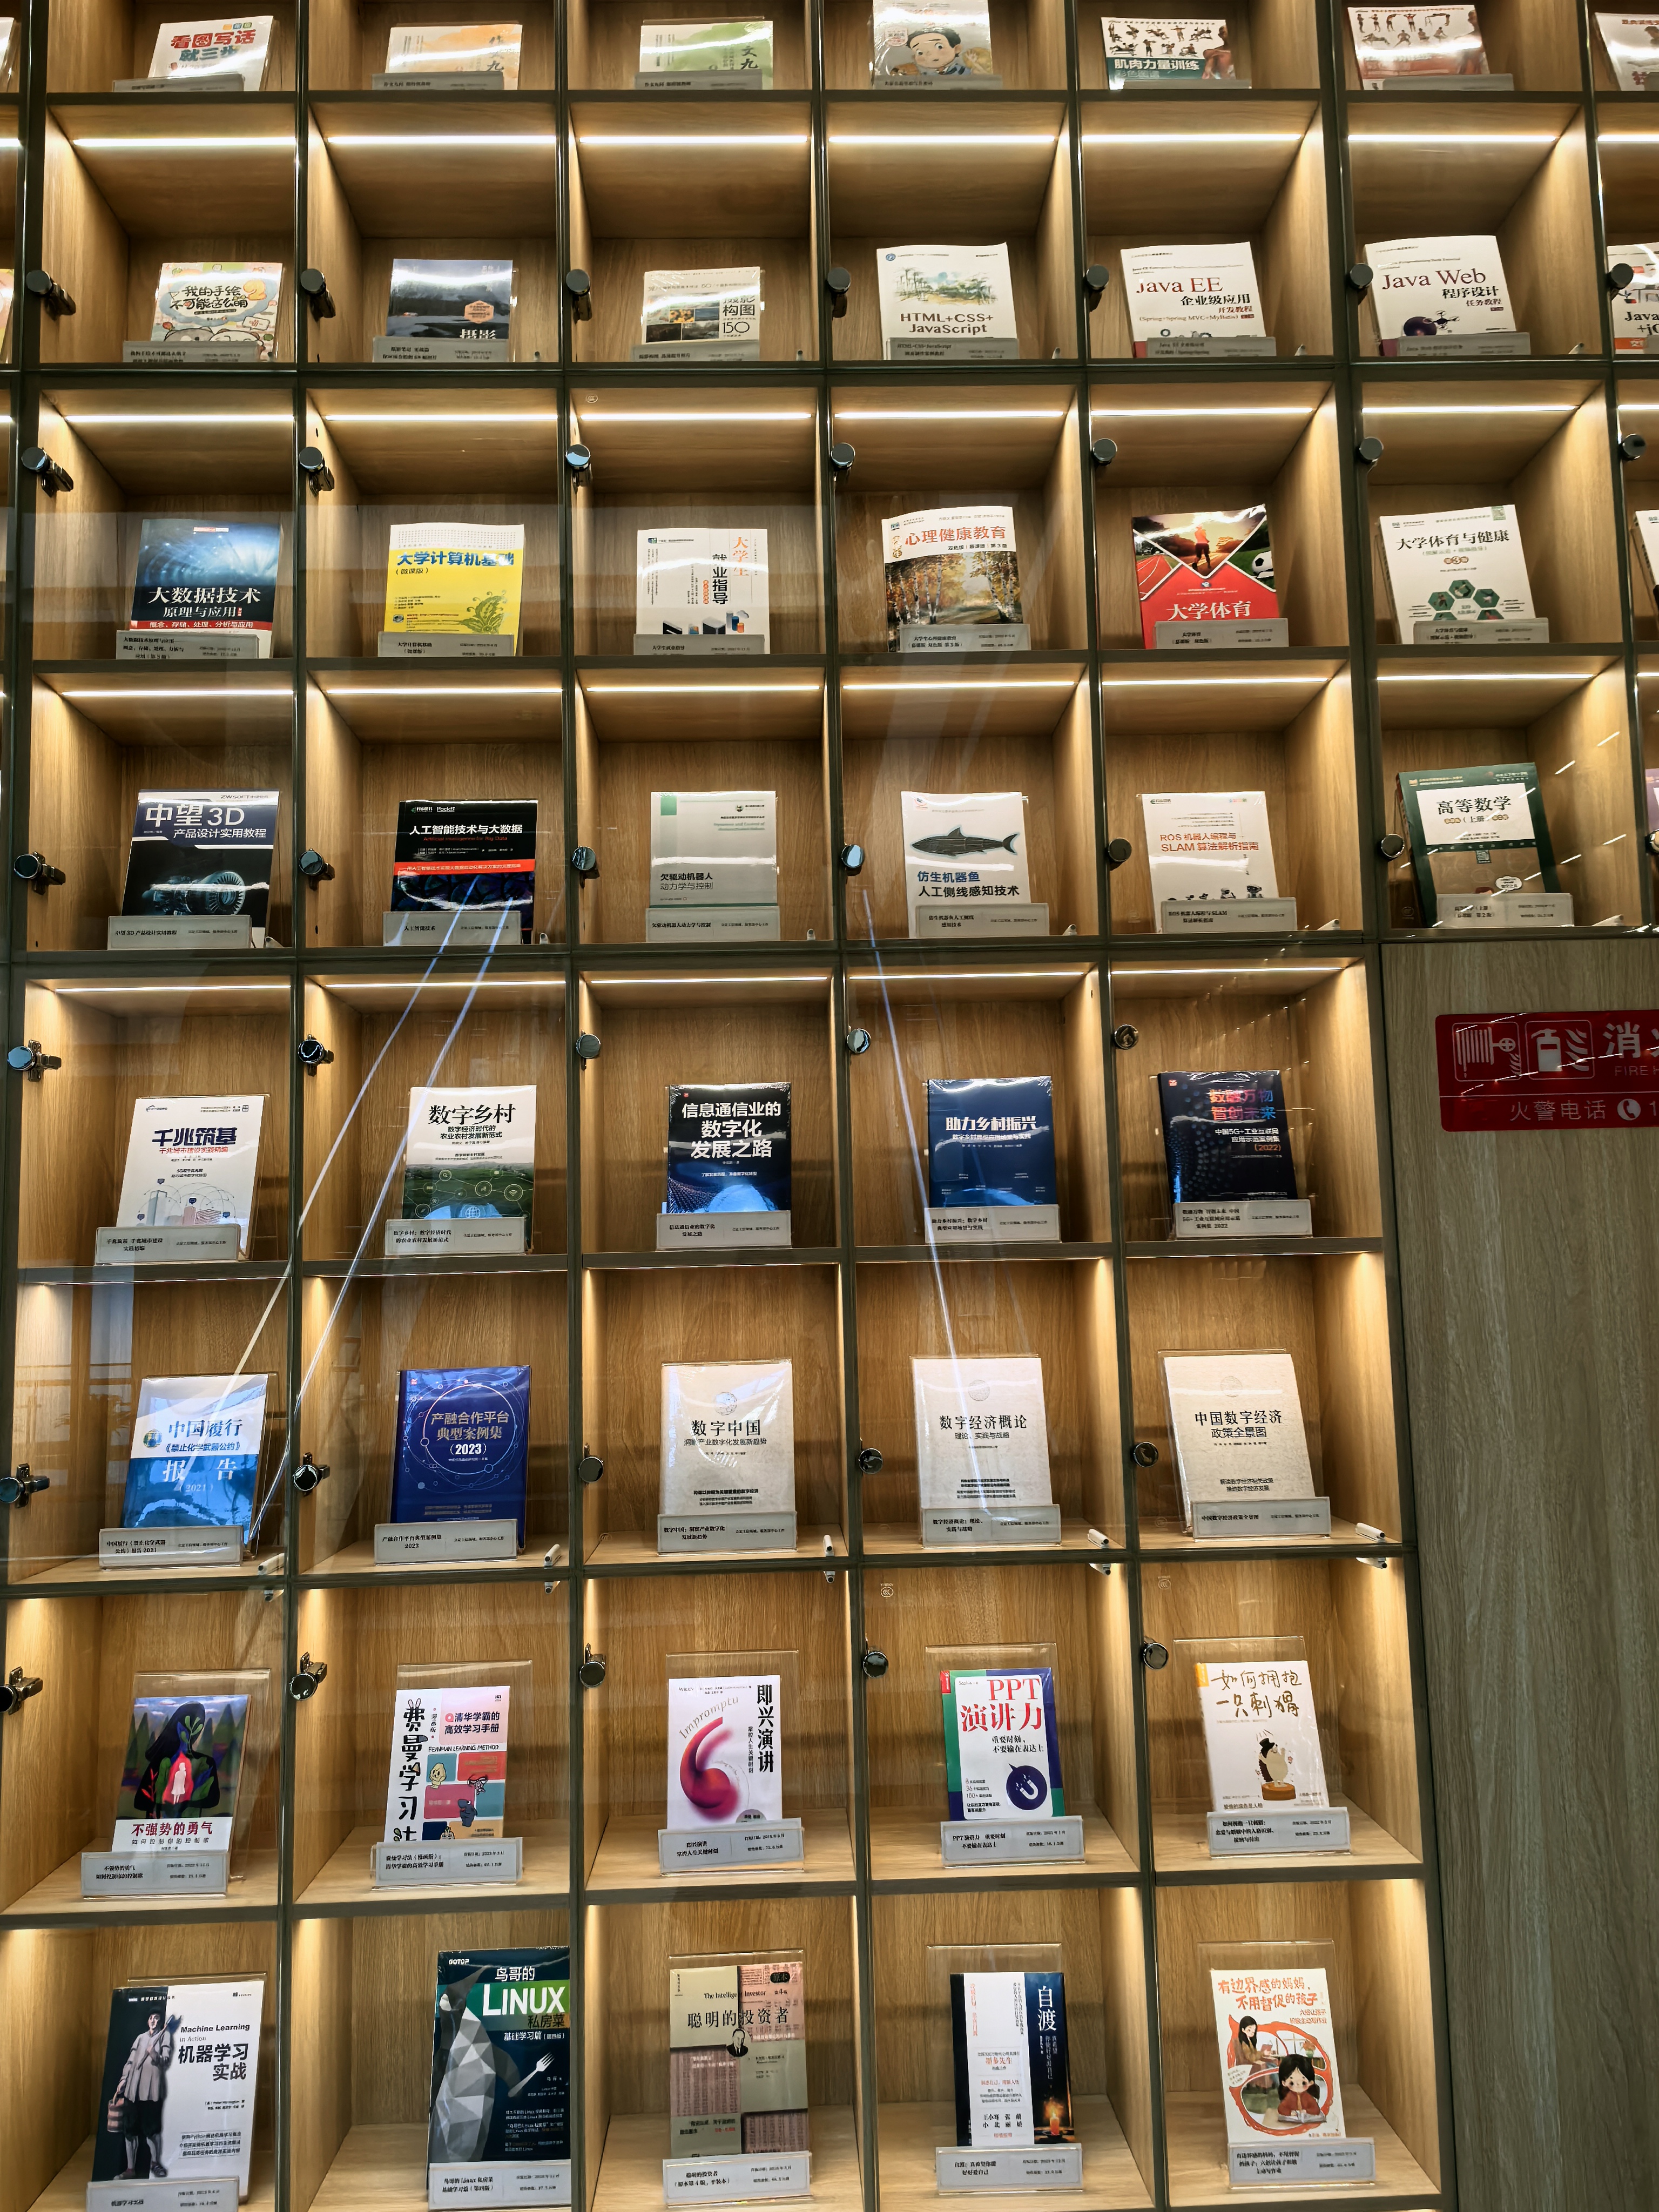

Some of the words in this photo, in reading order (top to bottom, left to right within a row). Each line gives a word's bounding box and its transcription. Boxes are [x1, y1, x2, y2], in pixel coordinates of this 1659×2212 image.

[171, 29, 257, 49] 看图写话
[1114, 58, 1200, 70] 肌肉力量训练
[1136, 279, 1184, 293] Java
[1190, 277, 1223, 292] EE
[1382, 274, 1431, 290] Java
[1434, 268, 1486, 285] Web
[181, 285, 241, 296] 我的手绘
[1441, 286, 1499, 299] 程序设计
[1180, 294, 1250, 307] 企业级应用
[1466, 298, 1502, 306] 任务教程
[723, 304, 755, 316] 构图
[900, 313, 994, 323] HTML+CSS+
[723, 321, 750, 334] 150
[909, 324, 988, 336] JavaScript
[905, 525, 1007, 546] 心理健康教育
[1395, 530, 1510, 551] 大学体育与健康
[397, 551, 515, 567] 大学计算机基础
[396, 567, 429, 575] （微课版）
[147, 587, 261, 604] 大数据技术
[163, 606, 237, 617] 原理与应用
[1166, 601, 1252, 621] 大学体育
[1436, 795, 1511, 814] 高等数学
[145, 804, 245, 827] 中望3D
[173, 828, 267, 838] 产品设计实用教程
[409, 824, 523, 835] 人工智能技术与大数据
[1184, 832, 1237, 841] 机器人编程与
[1161, 843, 1195, 852] SLAM
[1196, 841, 1259, 852] 算法解析指南
[660, 872, 713, 881] 欠驱动机器人
[917, 871, 981, 883] 仿生机器鱼
[660, 882, 713, 891] 动力学与控制
[918, 885, 1020, 898] 人工侧线感知技术
[1614, 1065, 1649, 1080] FIRE
[427, 1103, 516, 1125] 数字乡村
[682, 1102, 781, 1118] 信息通信业的
[1509, 1099, 1607, 1122] 火警电话
[447, 1125, 496, 1133] 数字经济时代的
[700, 1119, 763, 1138] 数字化
[946, 1116, 1037, 1131] 助力乡村振兴
[152, 1128, 238, 1147] 千兆筑基
[440, 1131, 502, 1139] 农业农村发展新范式
[691, 1140, 772, 1159] 发展之路
[430, 1411, 509, 1427] 产融合作平台
[939, 1414, 1028, 1431] 数字经济概论
[1195, 1410, 1283, 1426] 中国数字经济
[168, 1419, 243, 1438] 中国履行
[436, 1426, 502, 1441] 典型案例集
[689, 1419, 761, 1437] 数字中国
[954, 1432, 1010, 1440] 理论、实践与战略
[1211, 1427, 1267, 1439] 政策全景图
[165, 1442, 240, 1453] 《禁止化学武器公约》
[449, 1443, 489, 1456] （2023）
[683, 1438, 767, 1446] 洞察产业数字化发展新趋势
[163, 1457, 238, 1481] 报告
[1211, 1669, 1303, 1690] 如何拥抱
[987, 1678, 1041, 1701] PPT
[1216, 1690, 1299, 1718] 一只刺猬
[454, 1711, 500, 1722] 清华学霸的
[678, 1696, 739, 1740] Impromptu
[960, 1703, 1042, 1732] 演讲力
[444, 1723, 500, 1735] 高效学习手册
[756, 1684, 774, 1773] 即兴演讲
[993, 1744, 1044, 1754] 不要输在表达上
[131, 1820, 213, 1837] 不强势的勇气
[131, 1837, 210, 1845] 如何控制你的控制欲
[495, 1966, 535, 1981] 鸟哥的
[1218, 1977, 1311, 1994] 有边界感的妈妈，
[482, 1984, 565, 2016] LINUX
[1236, 1993, 1318, 2013] 不用督促的孩子
[1037, 1985, 1057, 2032] 自渡
[527, 2013, 565, 2029] 私房菜
[687, 2007, 788, 2029] 聪明的投资者
[180, 2025, 213, 2033] Machine
[215, 2022, 251, 2032] Learning
[503, 2031, 542, 2041] 基础学习篇
[177, 2043, 249, 2064] 机器学习
[212, 2062, 247, 2081] 实战
